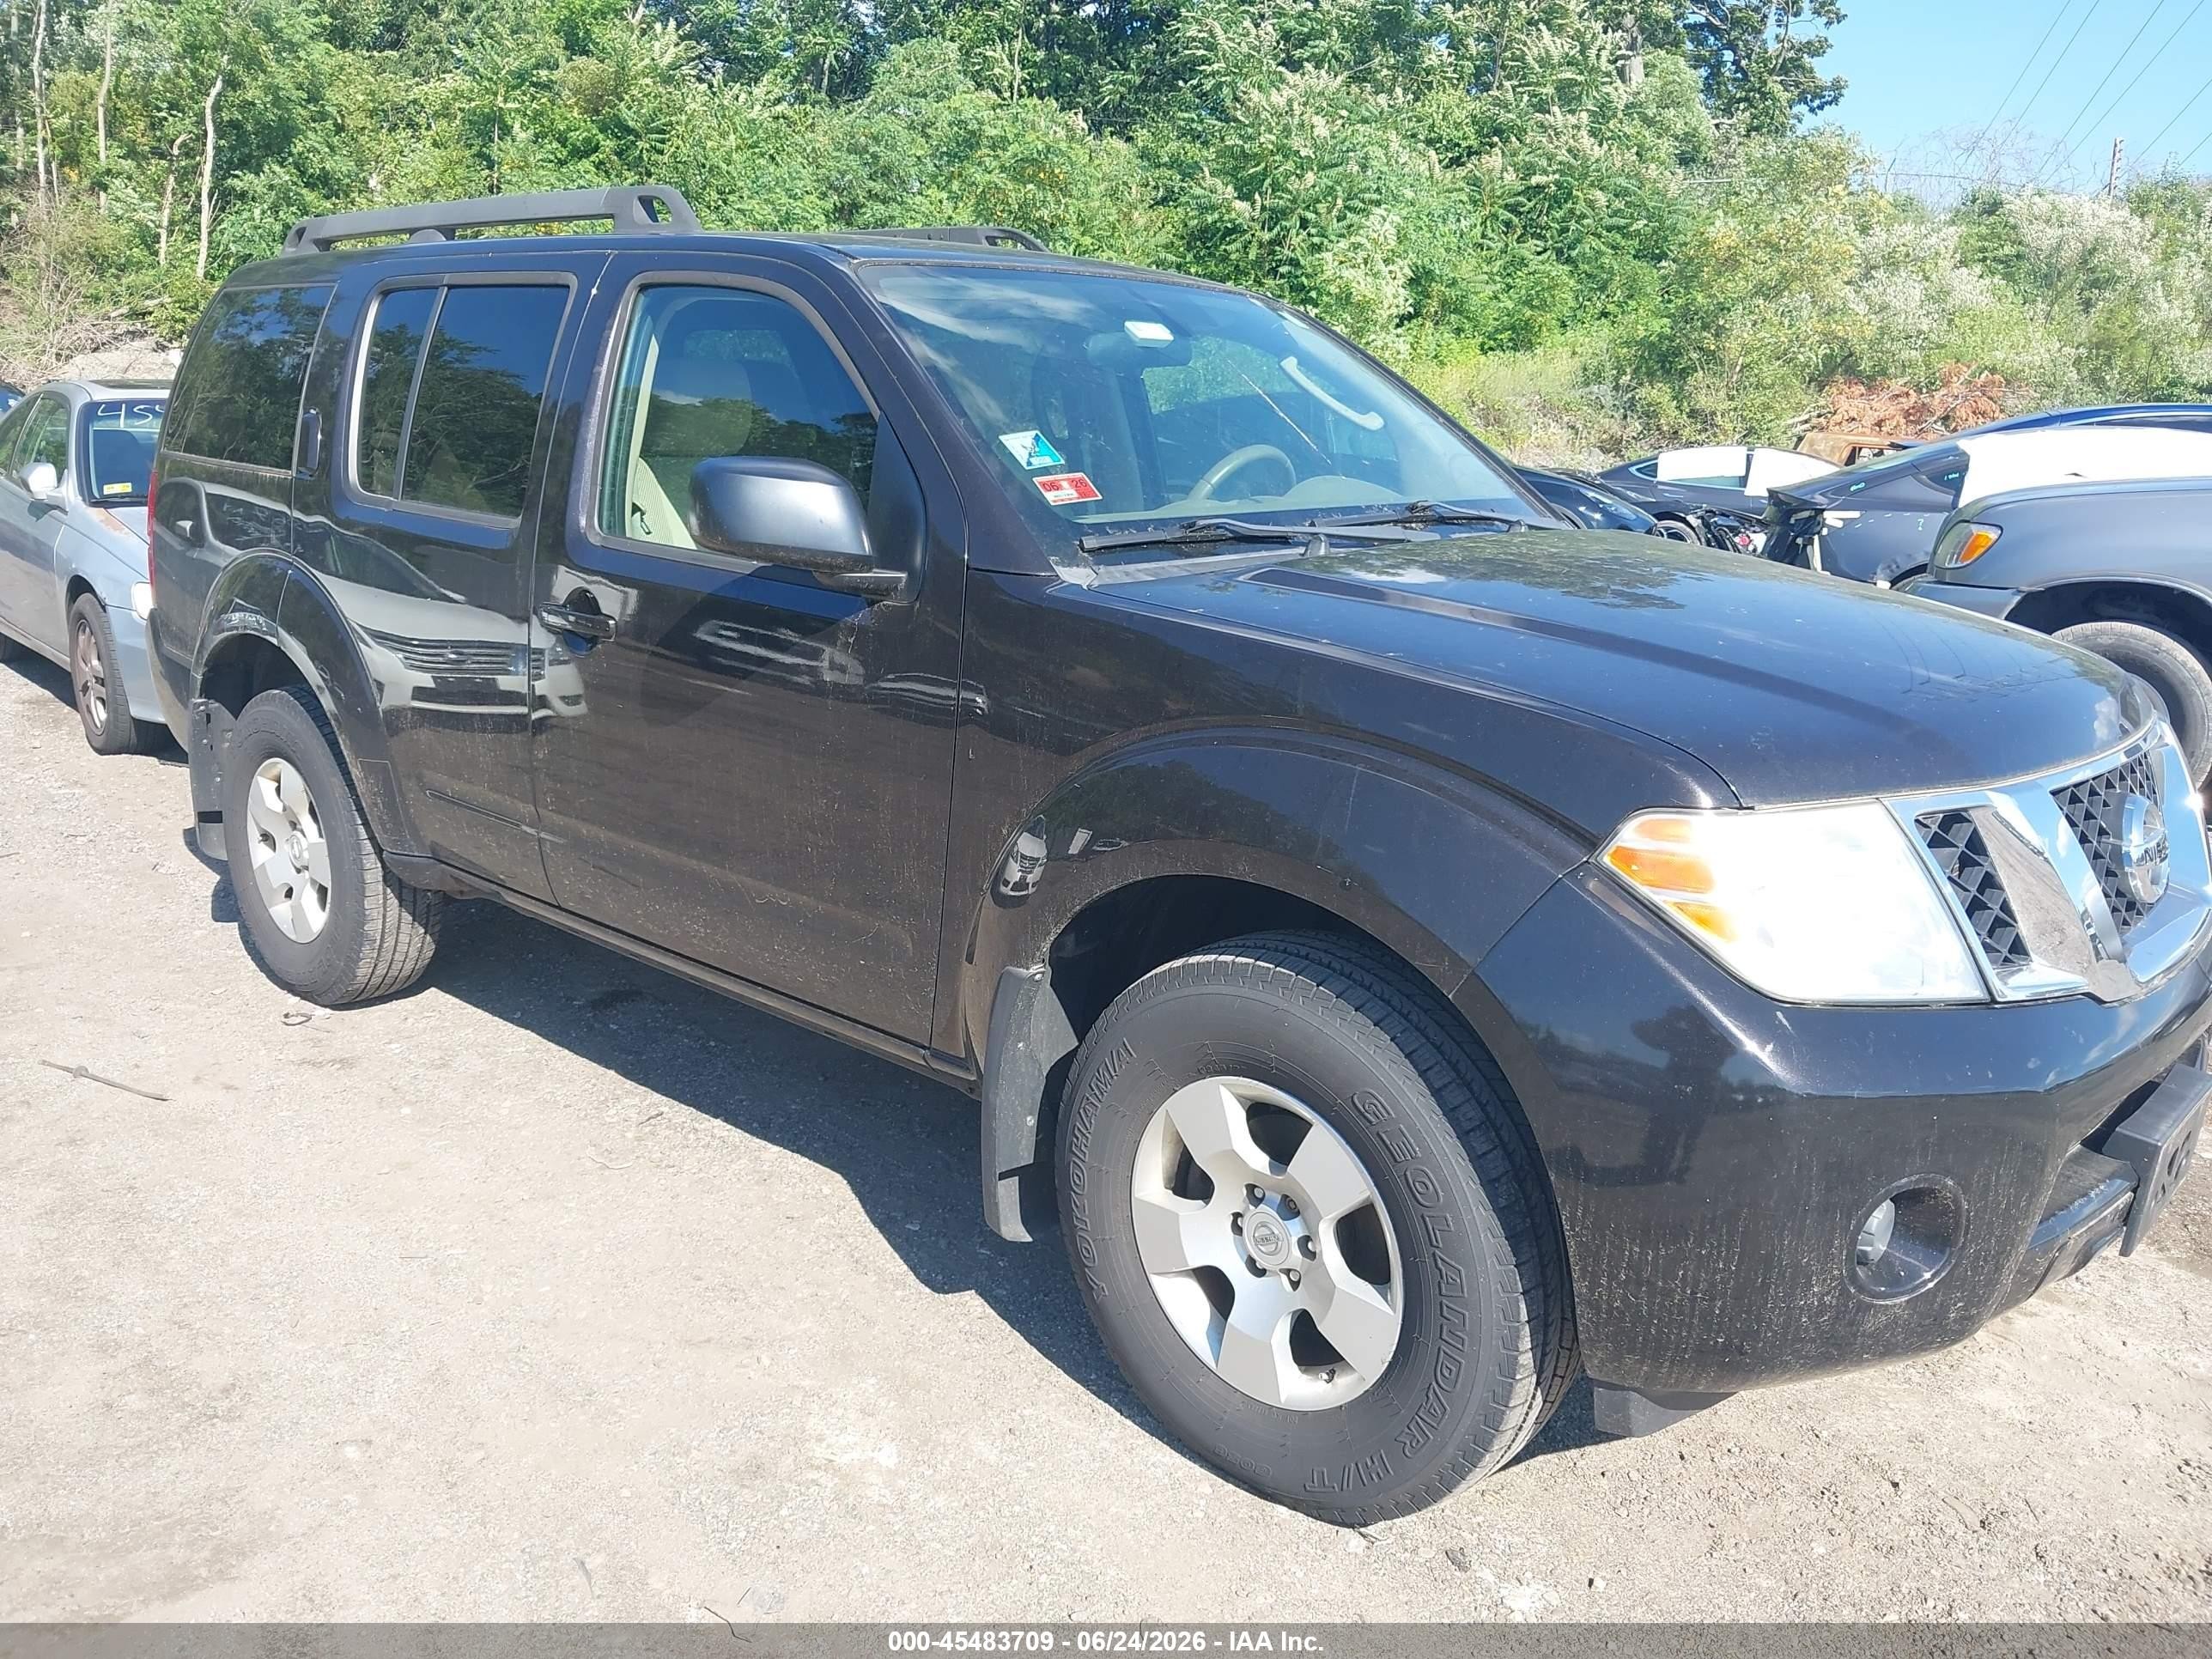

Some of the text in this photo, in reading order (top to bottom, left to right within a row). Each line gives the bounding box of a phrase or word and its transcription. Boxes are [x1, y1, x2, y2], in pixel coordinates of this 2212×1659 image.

[1042, 478, 1087, 492] 06 26
[1070, 1037, 1137, 1303] YOKOHAMA
[1351, 1090, 1469, 1460] GEOLANDAR
